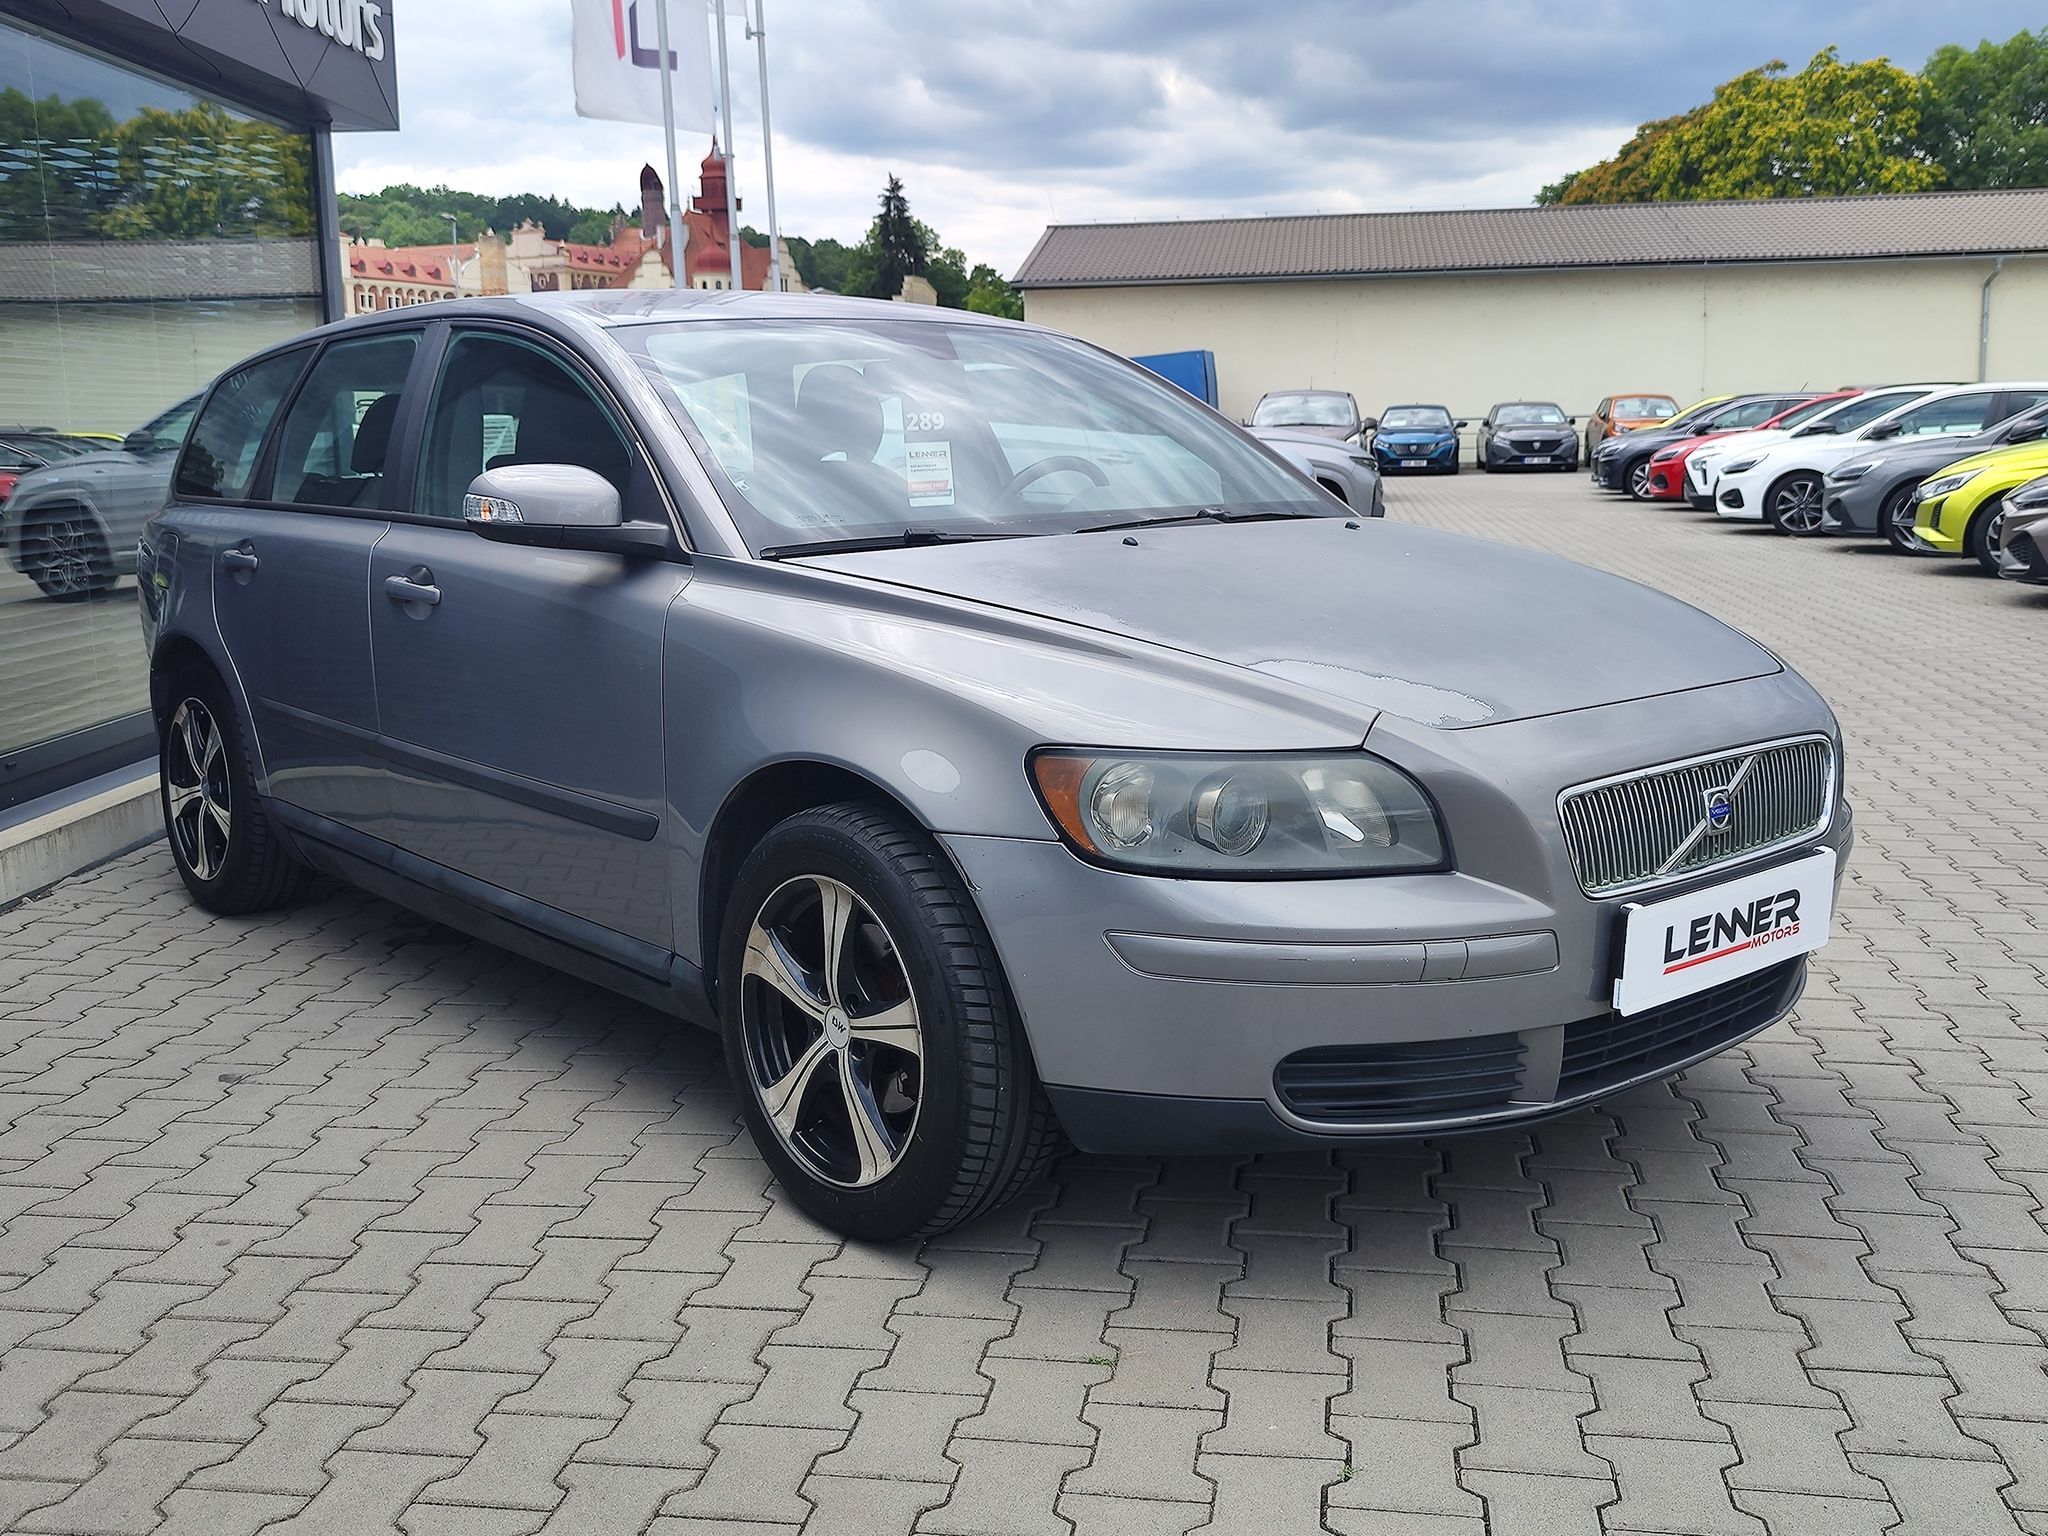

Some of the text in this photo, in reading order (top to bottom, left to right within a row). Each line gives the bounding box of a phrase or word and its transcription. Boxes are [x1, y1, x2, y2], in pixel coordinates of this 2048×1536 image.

[906, 411, 945, 431] 289
[1664, 888, 1801, 964] LENNER
[1750, 922, 1800, 949] MOTORS
